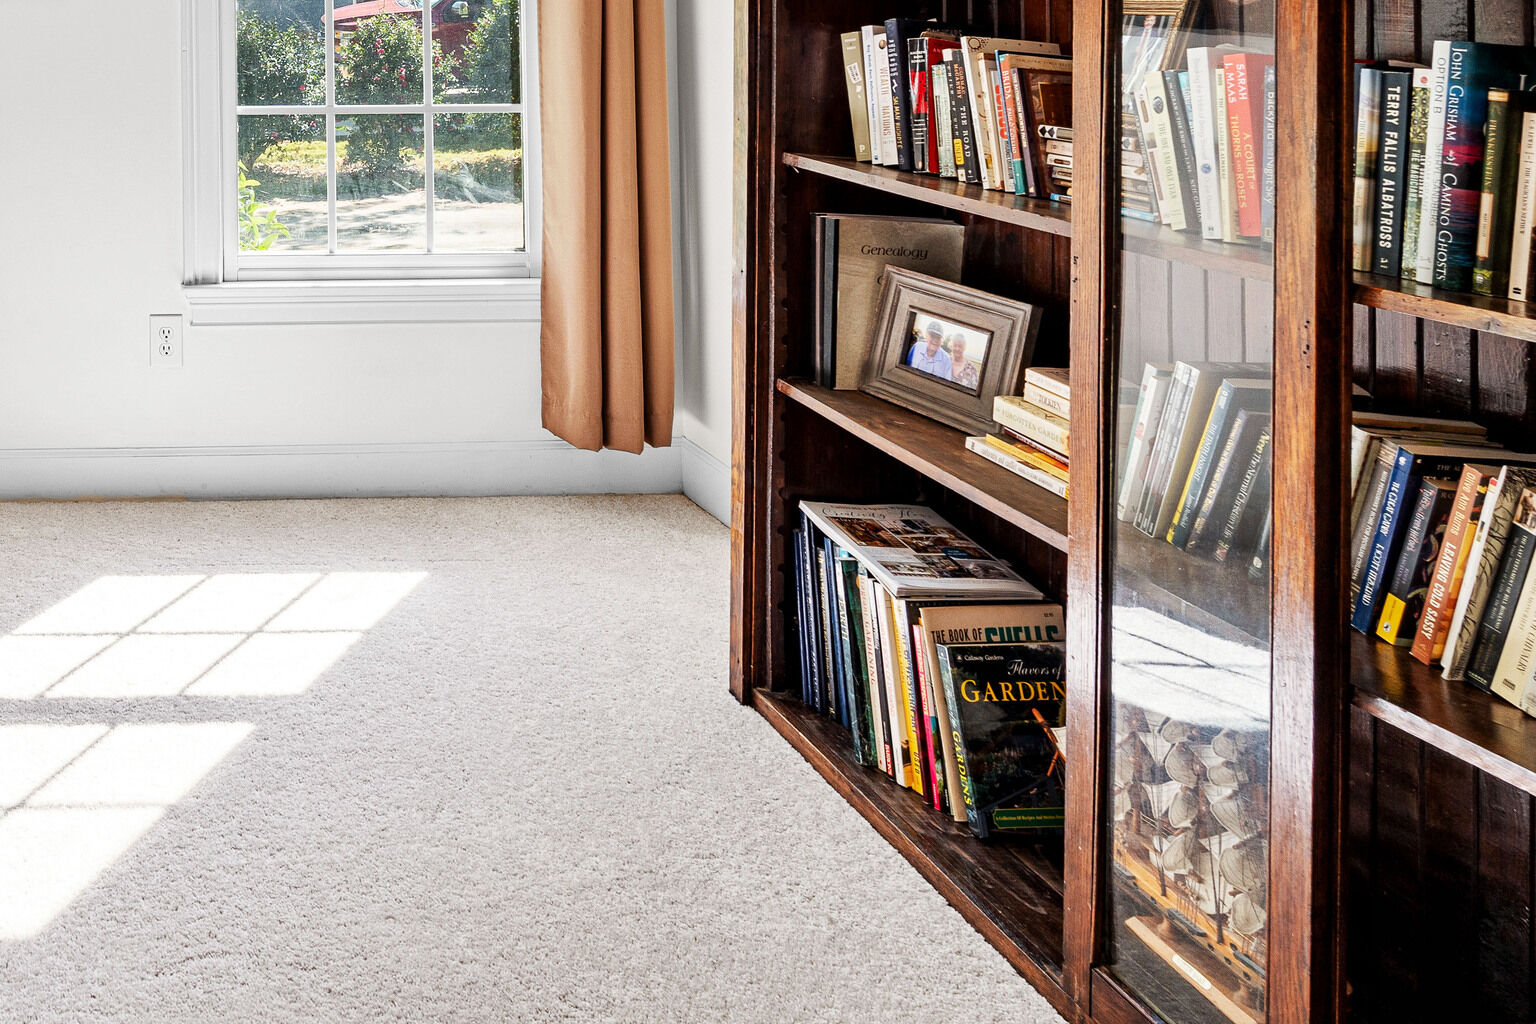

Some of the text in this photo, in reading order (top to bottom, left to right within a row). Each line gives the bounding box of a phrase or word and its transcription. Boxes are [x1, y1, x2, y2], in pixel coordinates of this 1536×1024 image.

[1003, 70, 1011, 99] BRIDA
[1226, 72, 1235, 103] MAAS
[1237, 63, 1246, 100] SARAH
[1435, 57, 1445, 102] OPTION
[963, 130, 971, 157] ROAD
[1231, 115, 1246, 208] THORNS ROSES
[1243, 131, 1254, 180] A COURT
[1437, 47, 1466, 281] JOHN GRISHAM CAMINO GHOSTS
[1381, 86, 1400, 248] TERRY FALLIS ALBATROSS
[860, 244, 929, 261] Genealogy
[1422, 471, 1475, 640] Olive Ann Burns LEAVING COLD SASSY
[931, 630, 946, 644] THE
[948, 628, 970, 642] BOOK
[972, 627, 983, 640] OF
[960, 678, 1067, 703] GARDEN
[951, 729, 973, 806] GARDENS
